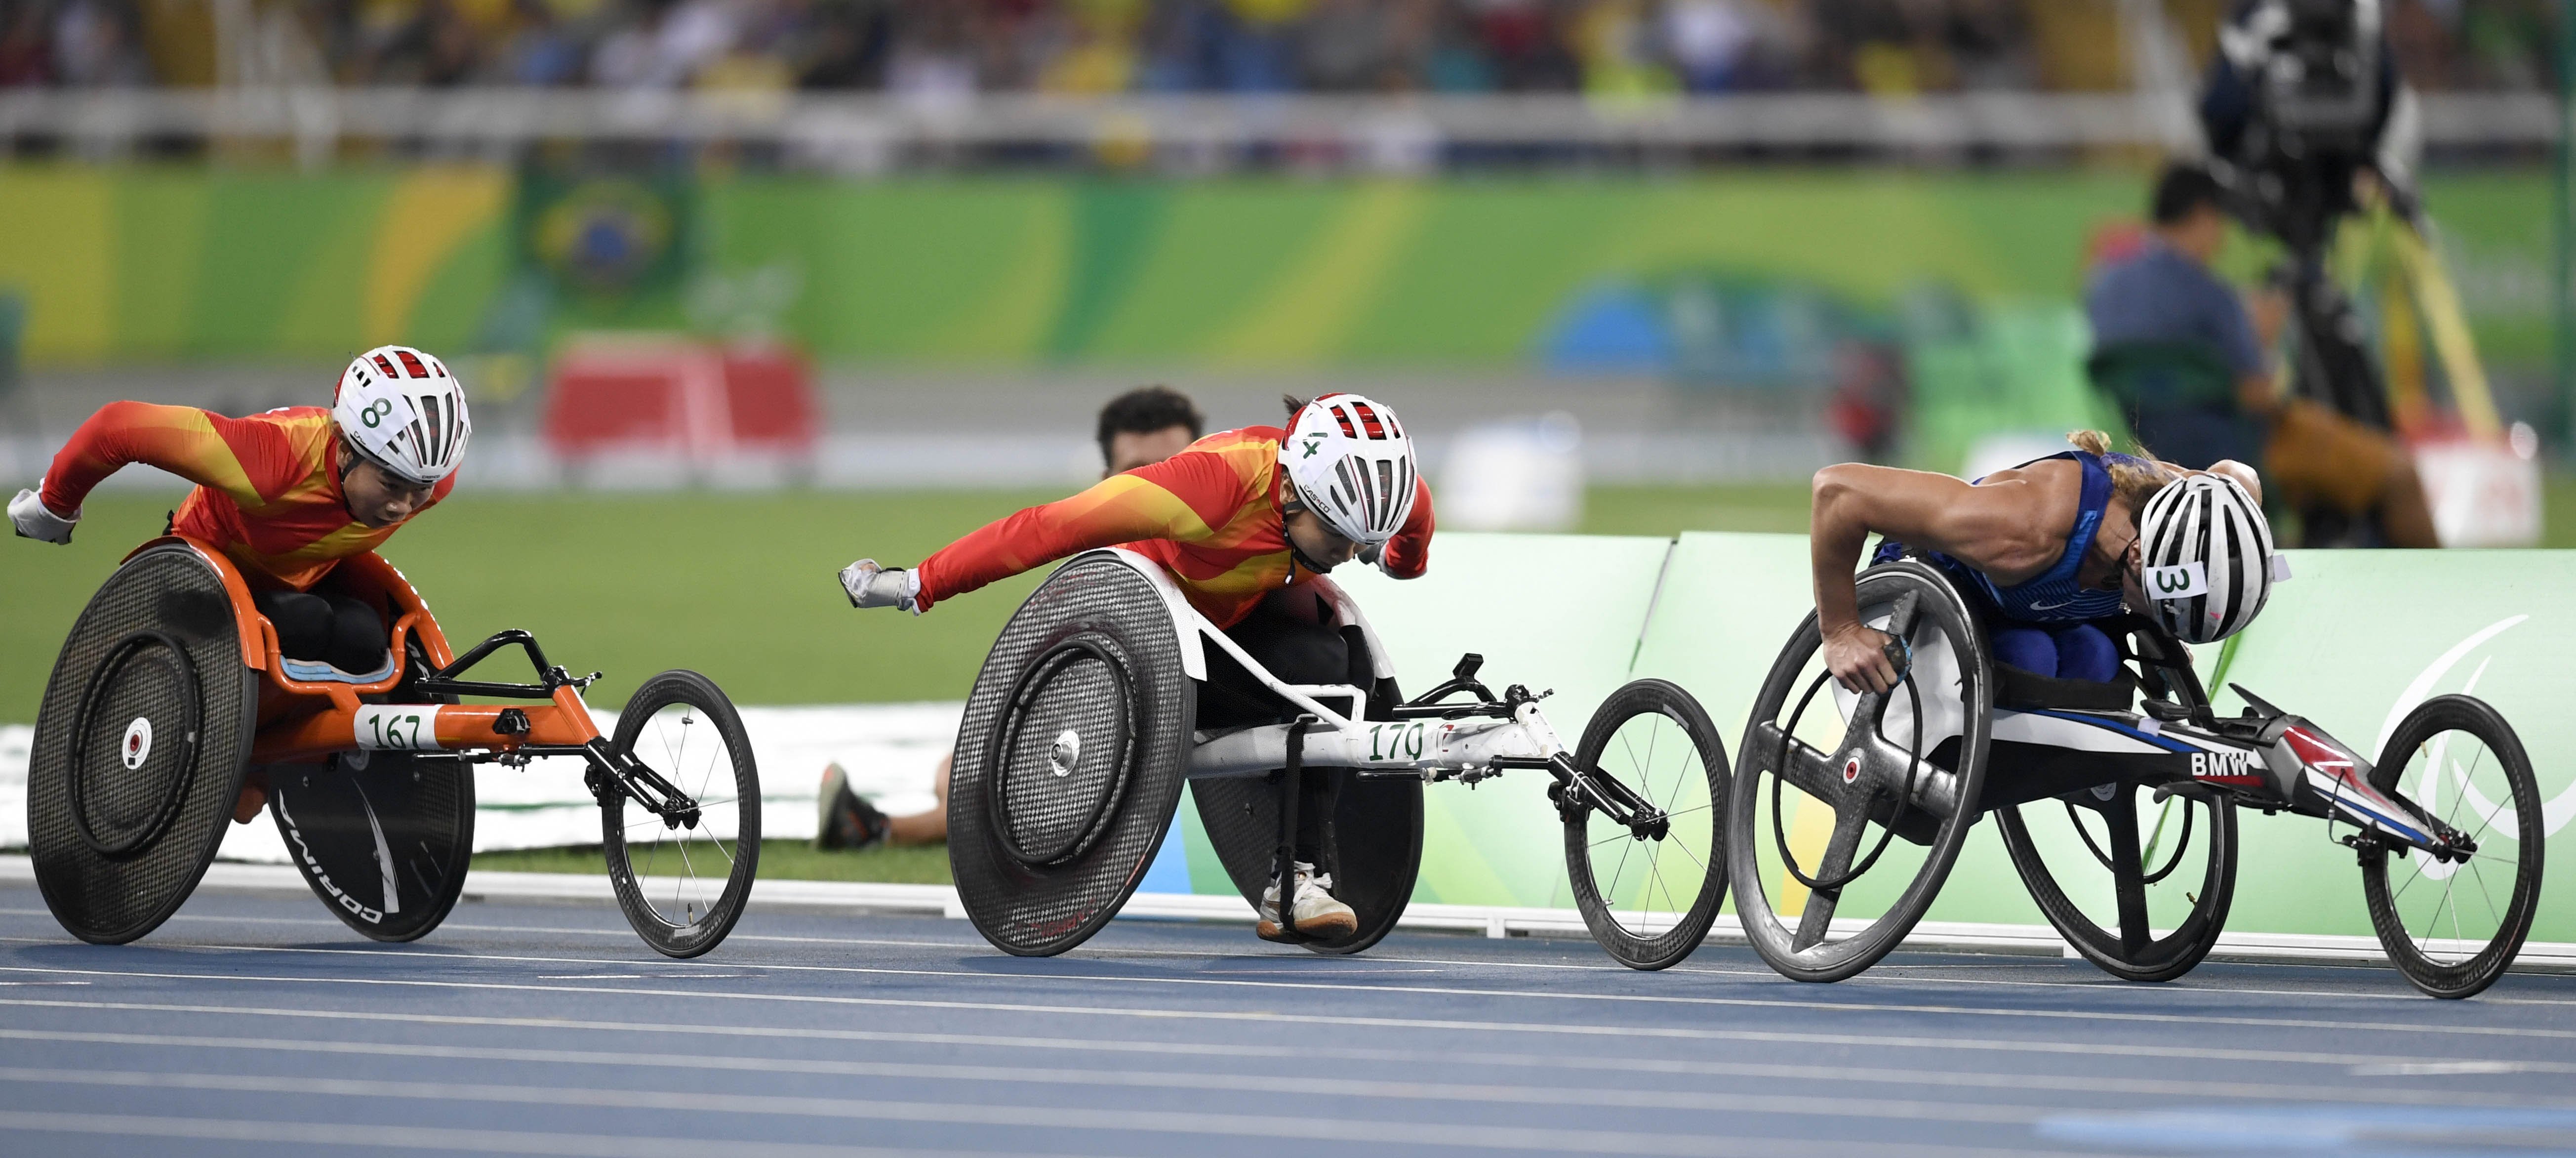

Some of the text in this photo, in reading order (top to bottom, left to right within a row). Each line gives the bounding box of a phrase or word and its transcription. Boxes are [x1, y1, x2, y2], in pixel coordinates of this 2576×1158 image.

[361, 398, 392, 428] 8
[1302, 432, 1328, 459] 4
[2156, 568, 2190, 593] 3
[369, 714, 420, 750] 167
[1369, 723, 1424, 761] 170
[2191, 752, 2248, 776] BMW
[279, 789, 383, 924] CORIMA
